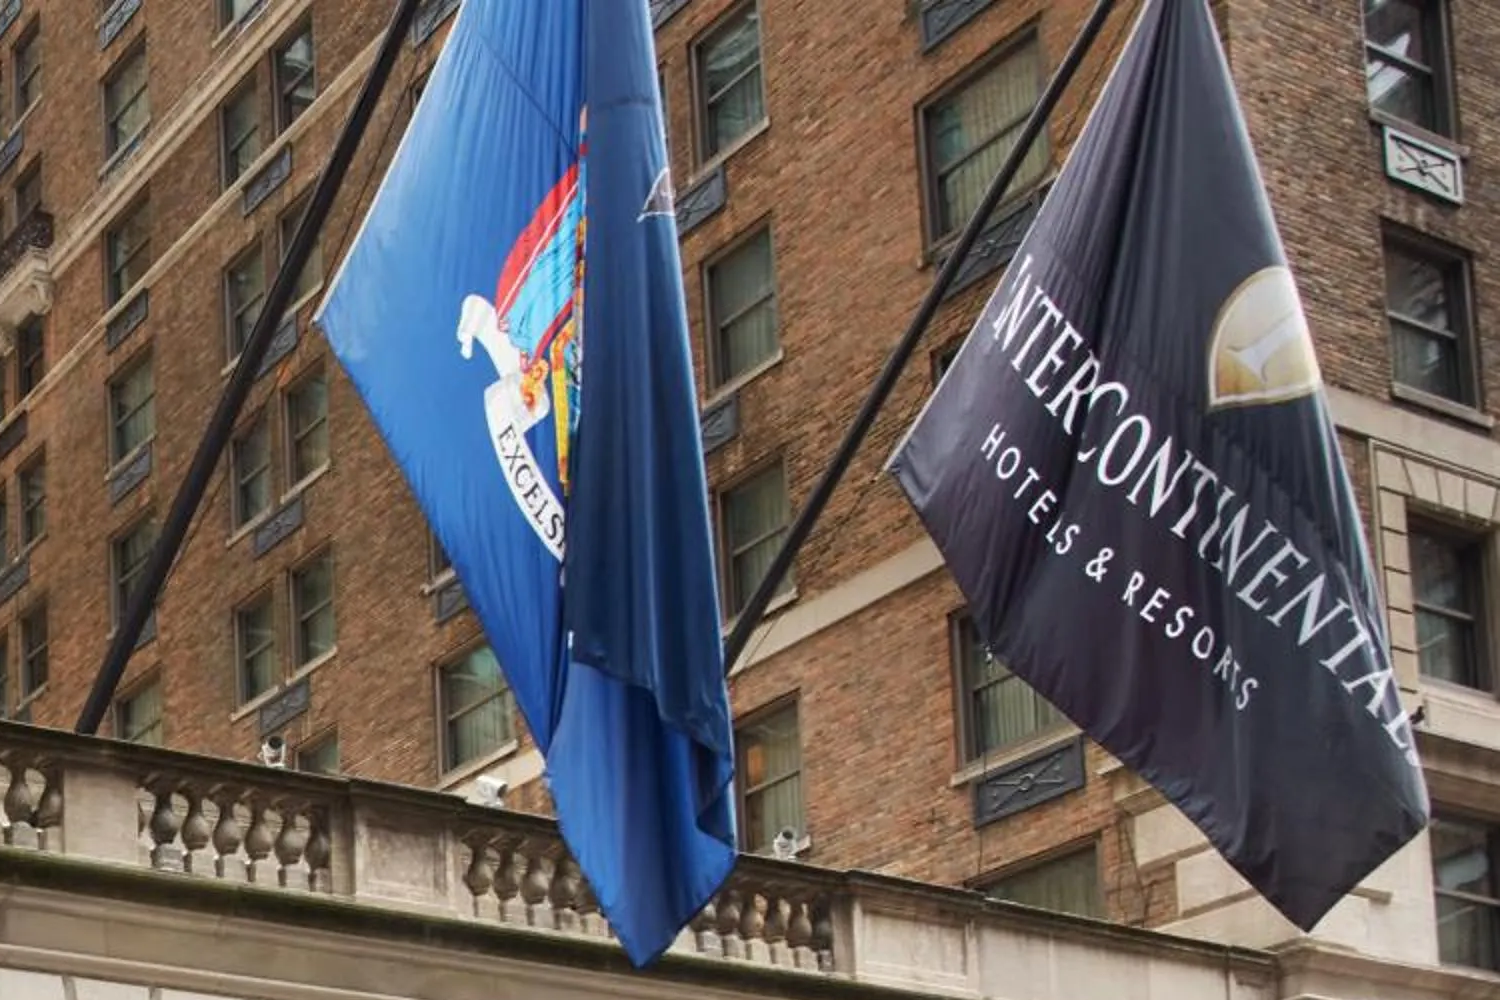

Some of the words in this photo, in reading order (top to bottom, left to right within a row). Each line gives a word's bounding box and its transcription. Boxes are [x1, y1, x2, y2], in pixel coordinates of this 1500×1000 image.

[980, 423, 1080, 555] HOTELS
[1085, 547, 1115, 583] &
[1122, 570, 1260, 711] RESORTS
